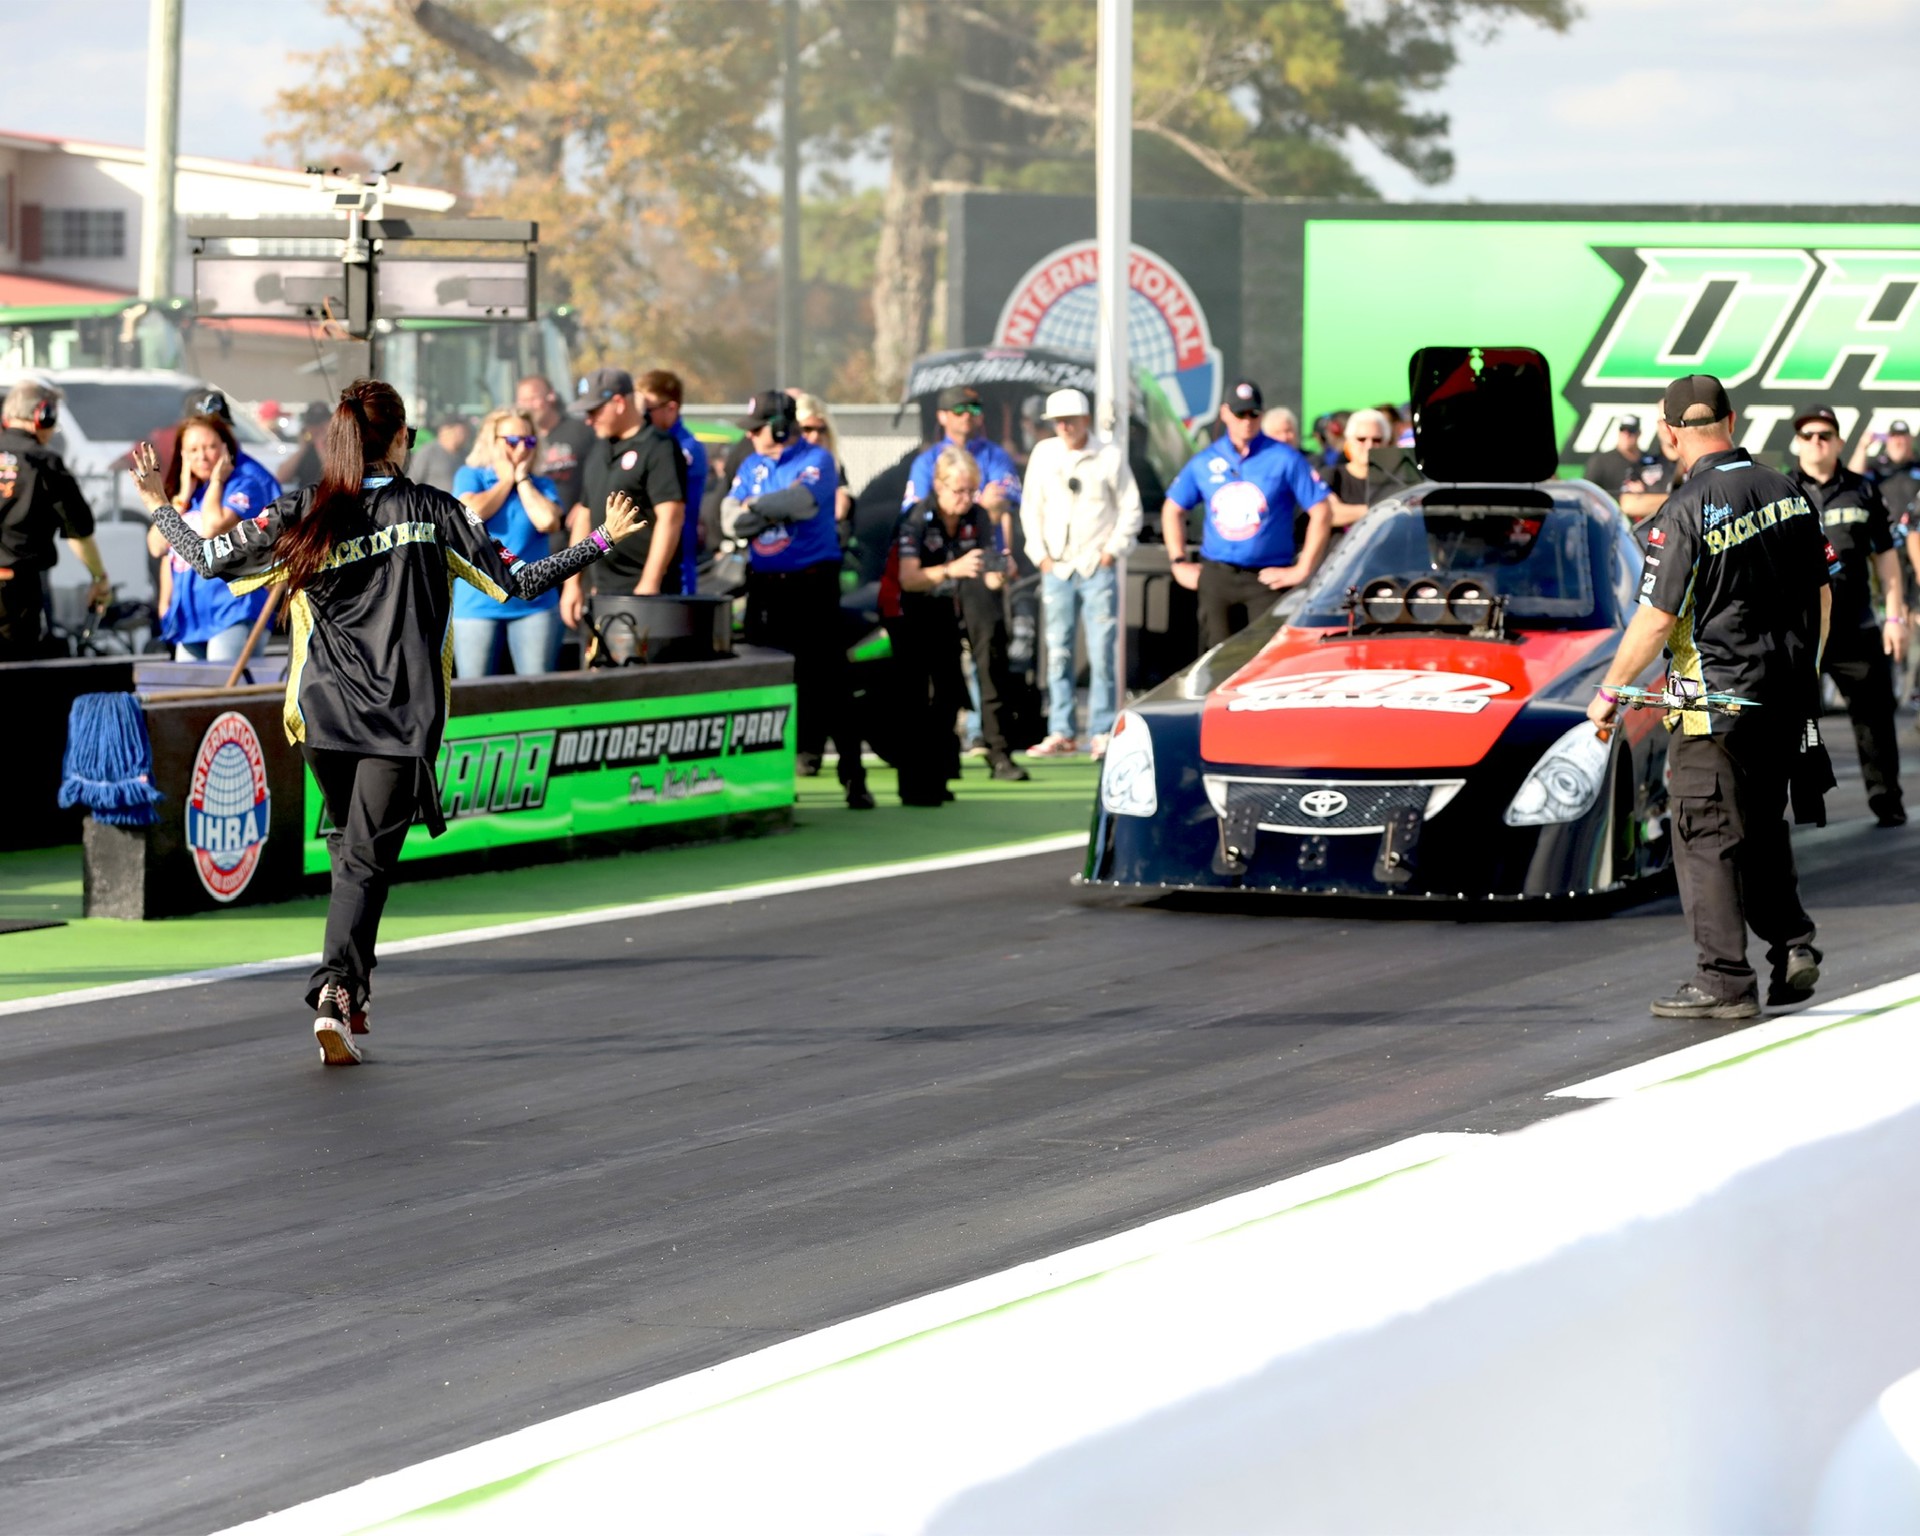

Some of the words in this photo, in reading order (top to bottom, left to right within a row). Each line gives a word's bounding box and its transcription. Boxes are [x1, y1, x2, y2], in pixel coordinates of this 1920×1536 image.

[312, 536, 366, 573] ACK
[368, 525, 394, 556] IN
[1703, 511, 1760, 555] BACK
[1758, 502, 1778, 530] IN
[1777, 496, 1811, 521] BLAC
[194, 720, 265, 800] INTERNATIONAL
[555, 716, 726, 767] MOTORSPORTS
[730, 709, 787, 747] PARK
[196, 810, 259, 851] IHRA
